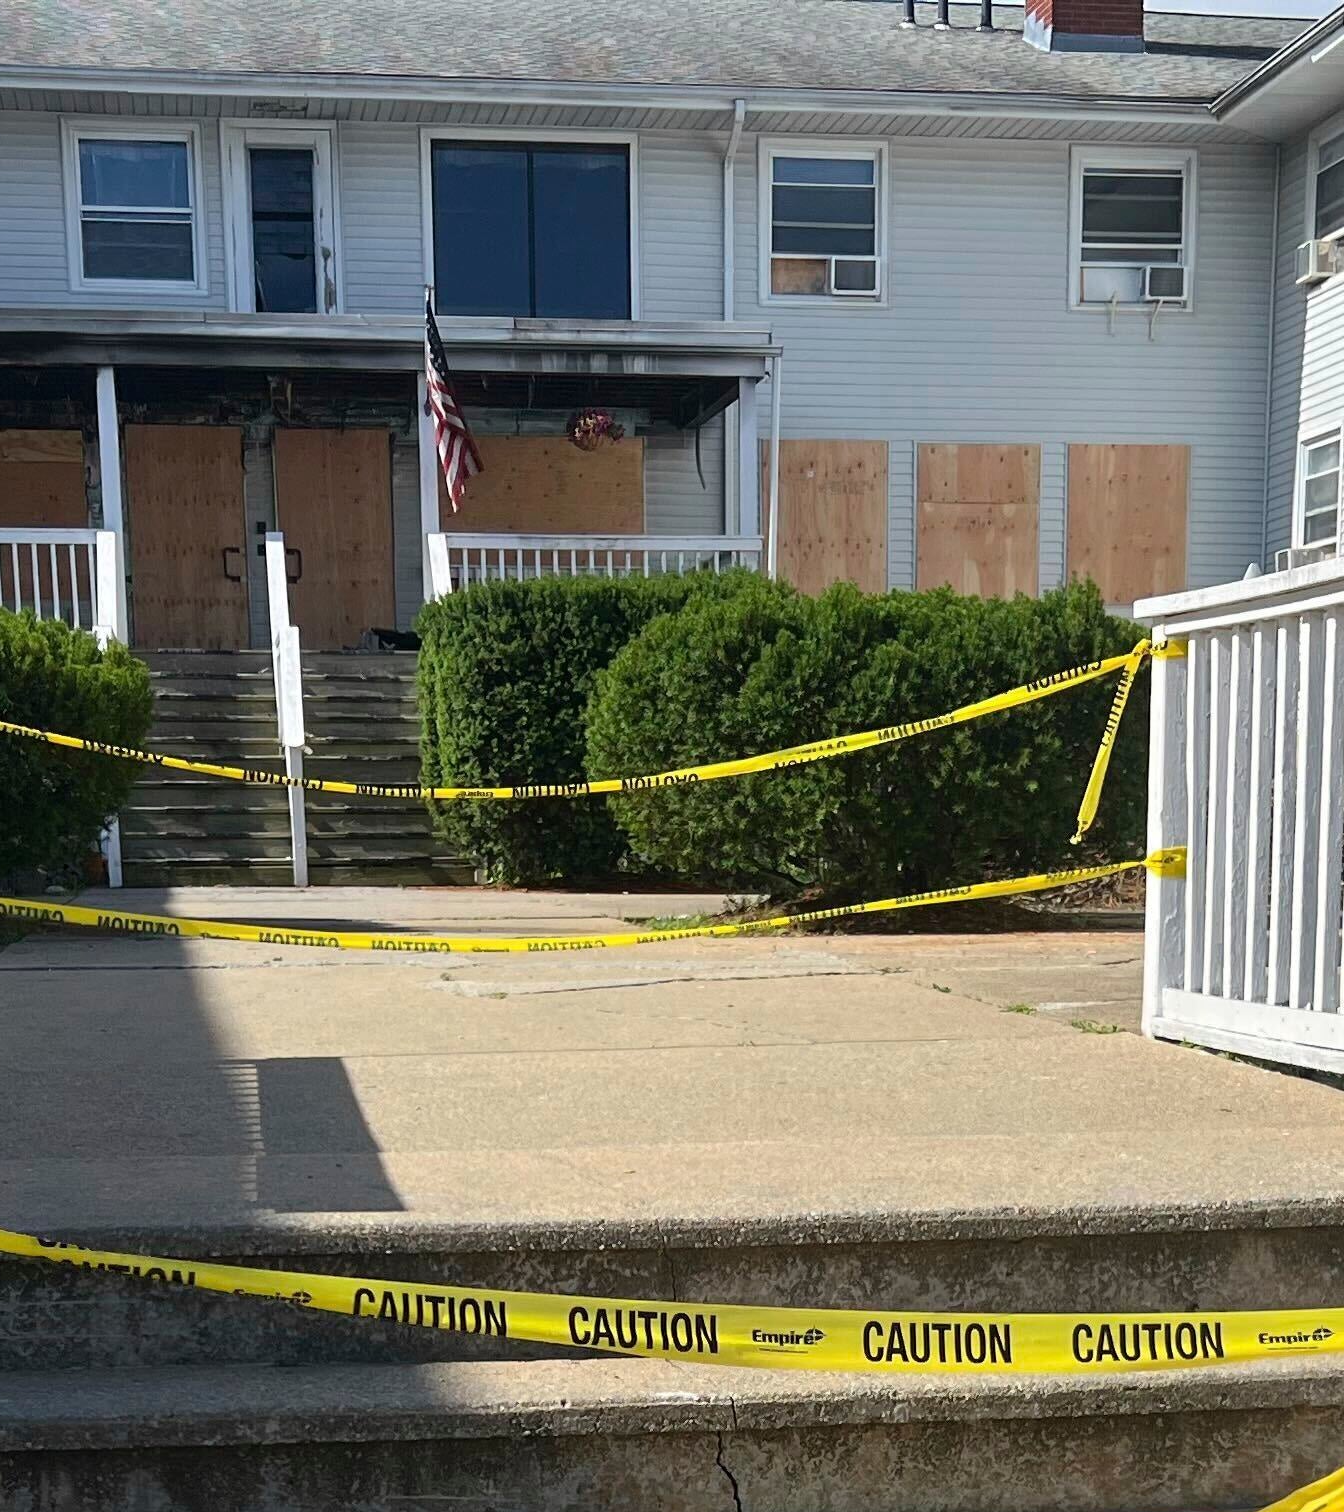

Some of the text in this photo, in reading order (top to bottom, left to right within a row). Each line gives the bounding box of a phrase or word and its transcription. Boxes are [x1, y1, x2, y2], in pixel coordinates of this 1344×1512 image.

[352, 1287, 508, 1337] CAUTION
[567, 1305, 719, 1355] CAUTION
[751, 1325, 817, 1347] Empire
[862, 1320, 1012, 1364] CAUTION
[1071, 1321, 1225, 1364] CAUTION
[1257, 1330, 1326, 1346] Empire
